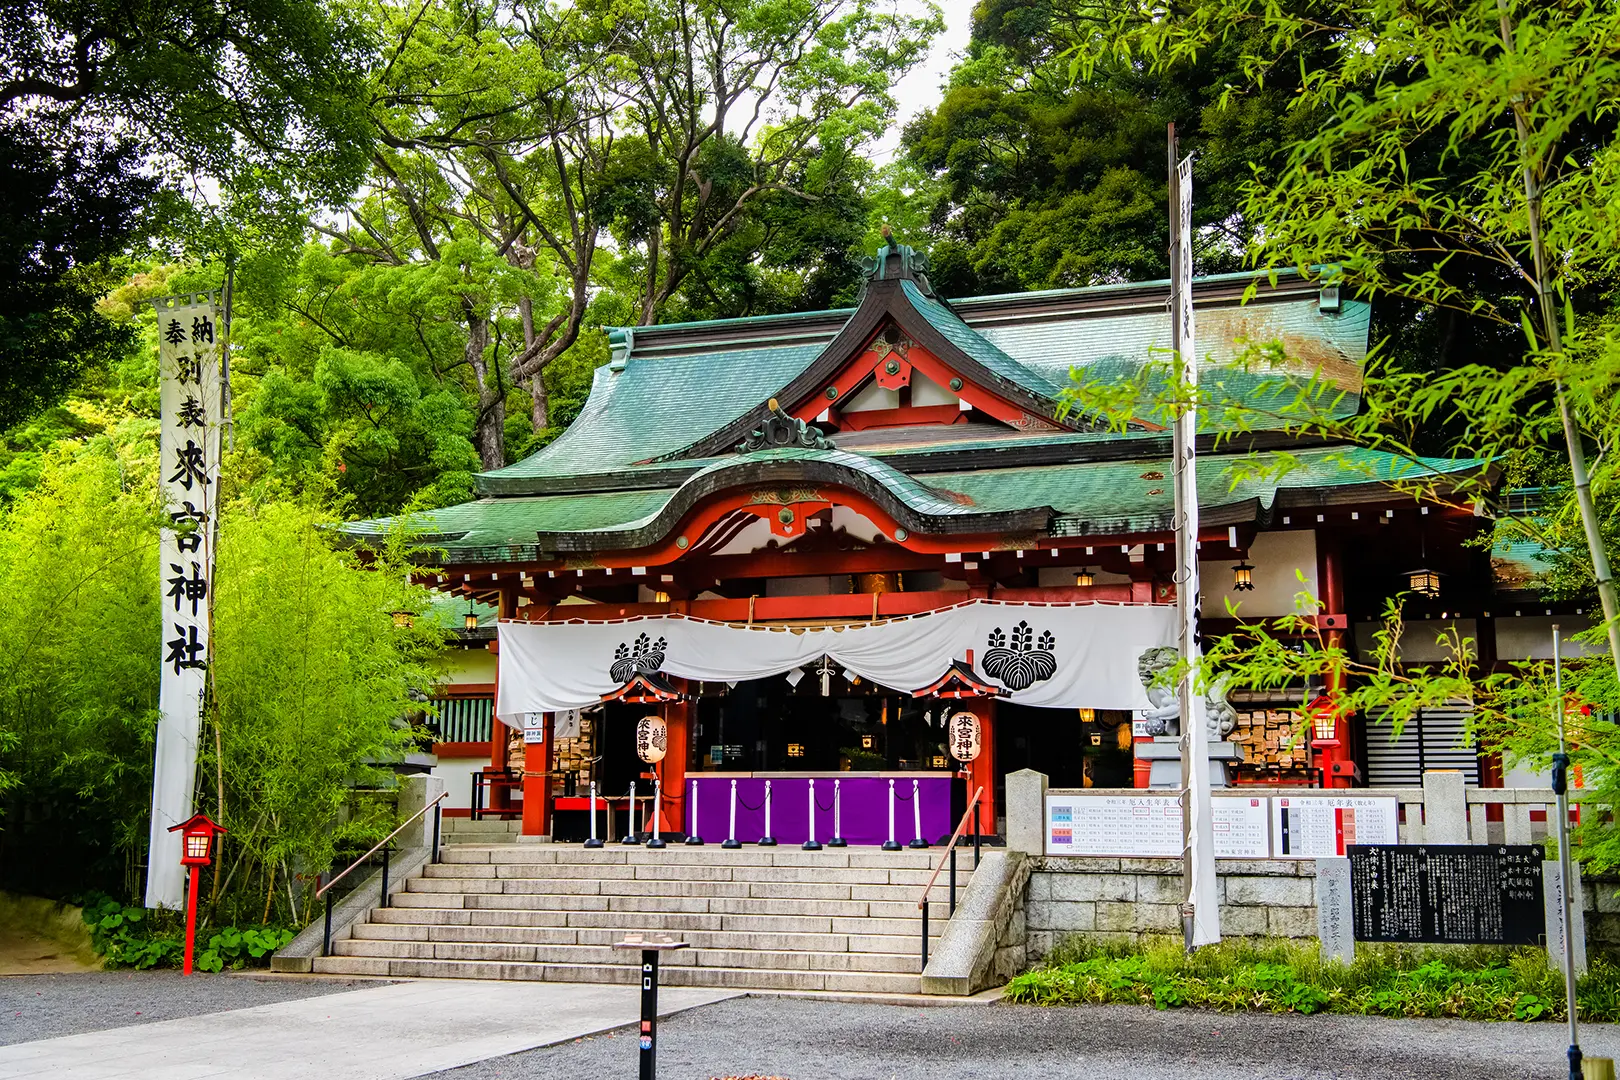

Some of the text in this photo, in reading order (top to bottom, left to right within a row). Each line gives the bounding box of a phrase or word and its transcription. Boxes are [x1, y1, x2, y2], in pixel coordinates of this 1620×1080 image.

[163, 316, 214, 346] 奉納
[957, 715, 973, 760] 來宮神社
